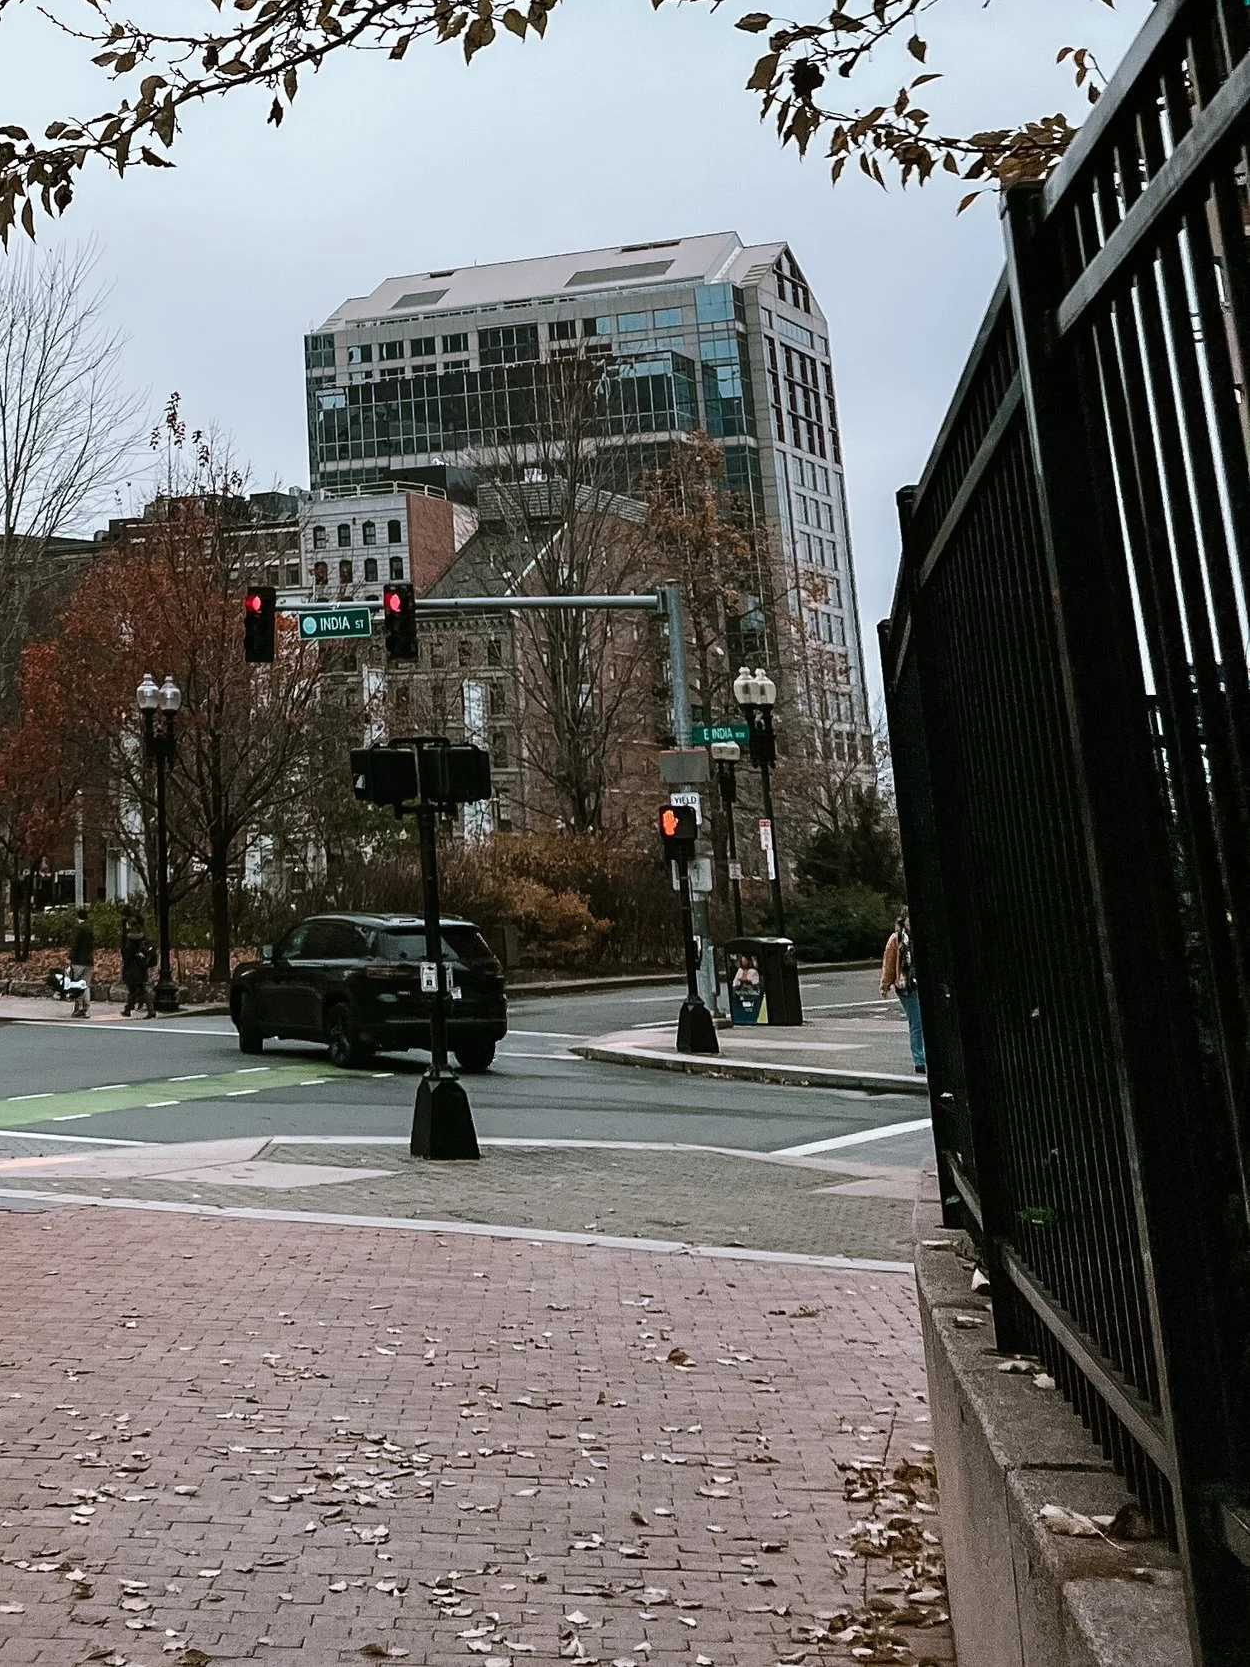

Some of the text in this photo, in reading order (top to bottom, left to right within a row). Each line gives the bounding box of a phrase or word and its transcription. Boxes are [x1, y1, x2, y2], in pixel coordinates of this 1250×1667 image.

[320, 616, 365, 632] INDIA ST
[703, 728, 710, 741] E
[711, 727, 733, 740] INDIA
[673, 795, 697, 805] YIELD
